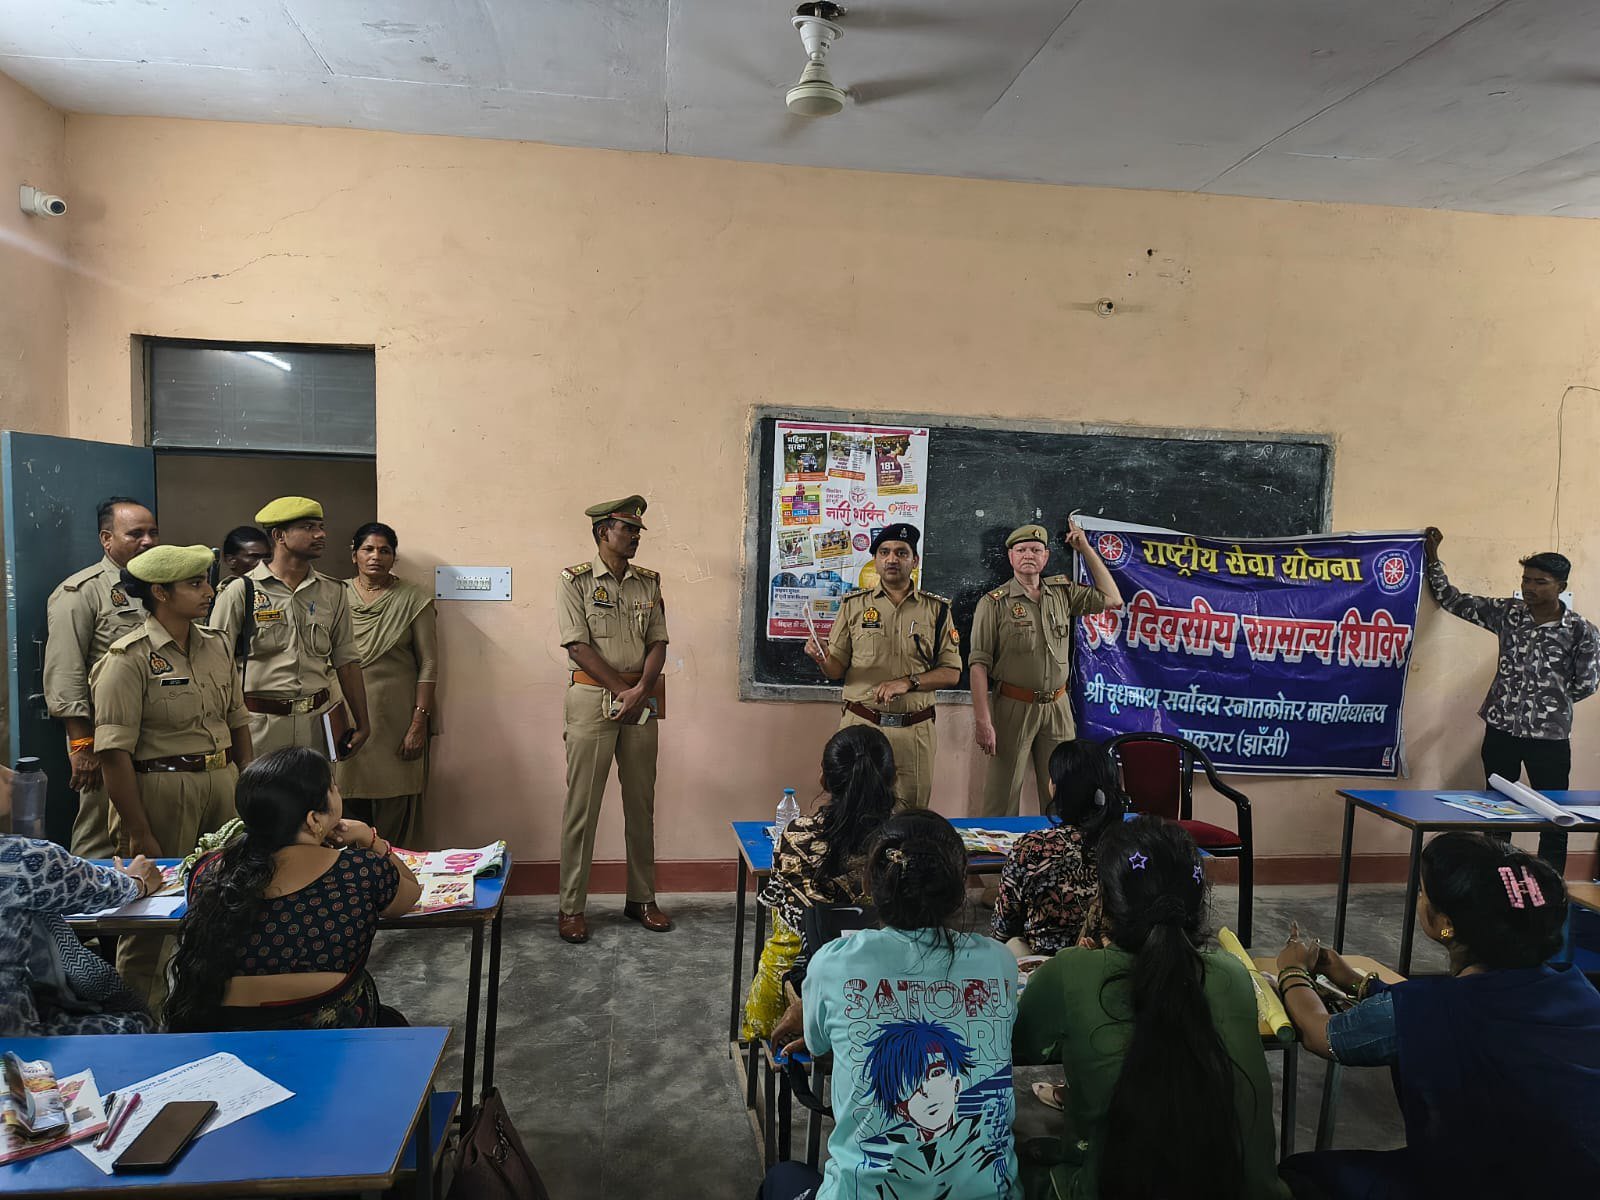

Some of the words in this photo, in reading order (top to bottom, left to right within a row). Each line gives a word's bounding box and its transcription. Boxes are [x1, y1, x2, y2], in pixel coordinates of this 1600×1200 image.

[787, 434, 808, 444] महिला
[787, 443, 806, 453] सुरक्षा
[880, 461, 895, 470] 181
[825, 500, 851, 526] नारी
[853, 501, 888, 527] शक्ति
[1142, 537, 1219, 577] राष्ट्रीय
[1224, 545, 1276, 577] सेवा
[1281, 547, 1364, 581] योजना
[1127, 590, 1238, 657] दिवसीय
[1241, 615, 1337, 665] सामान्य
[1338, 607, 1411, 667] शिविर
[1084, 673, 1107, 704] श्री
[1106, 683, 1161, 714] दूधनाथ
[1162, 683, 1223, 716] सर्वोदय
[1223, 691, 1307, 721] स्नातकोत्तर
[1307, 695, 1389, 724] महाविद्यालय
[1237, 726, 1290, 758] (झाँसी)
[843, 979, 1013, 1019] SATORU
